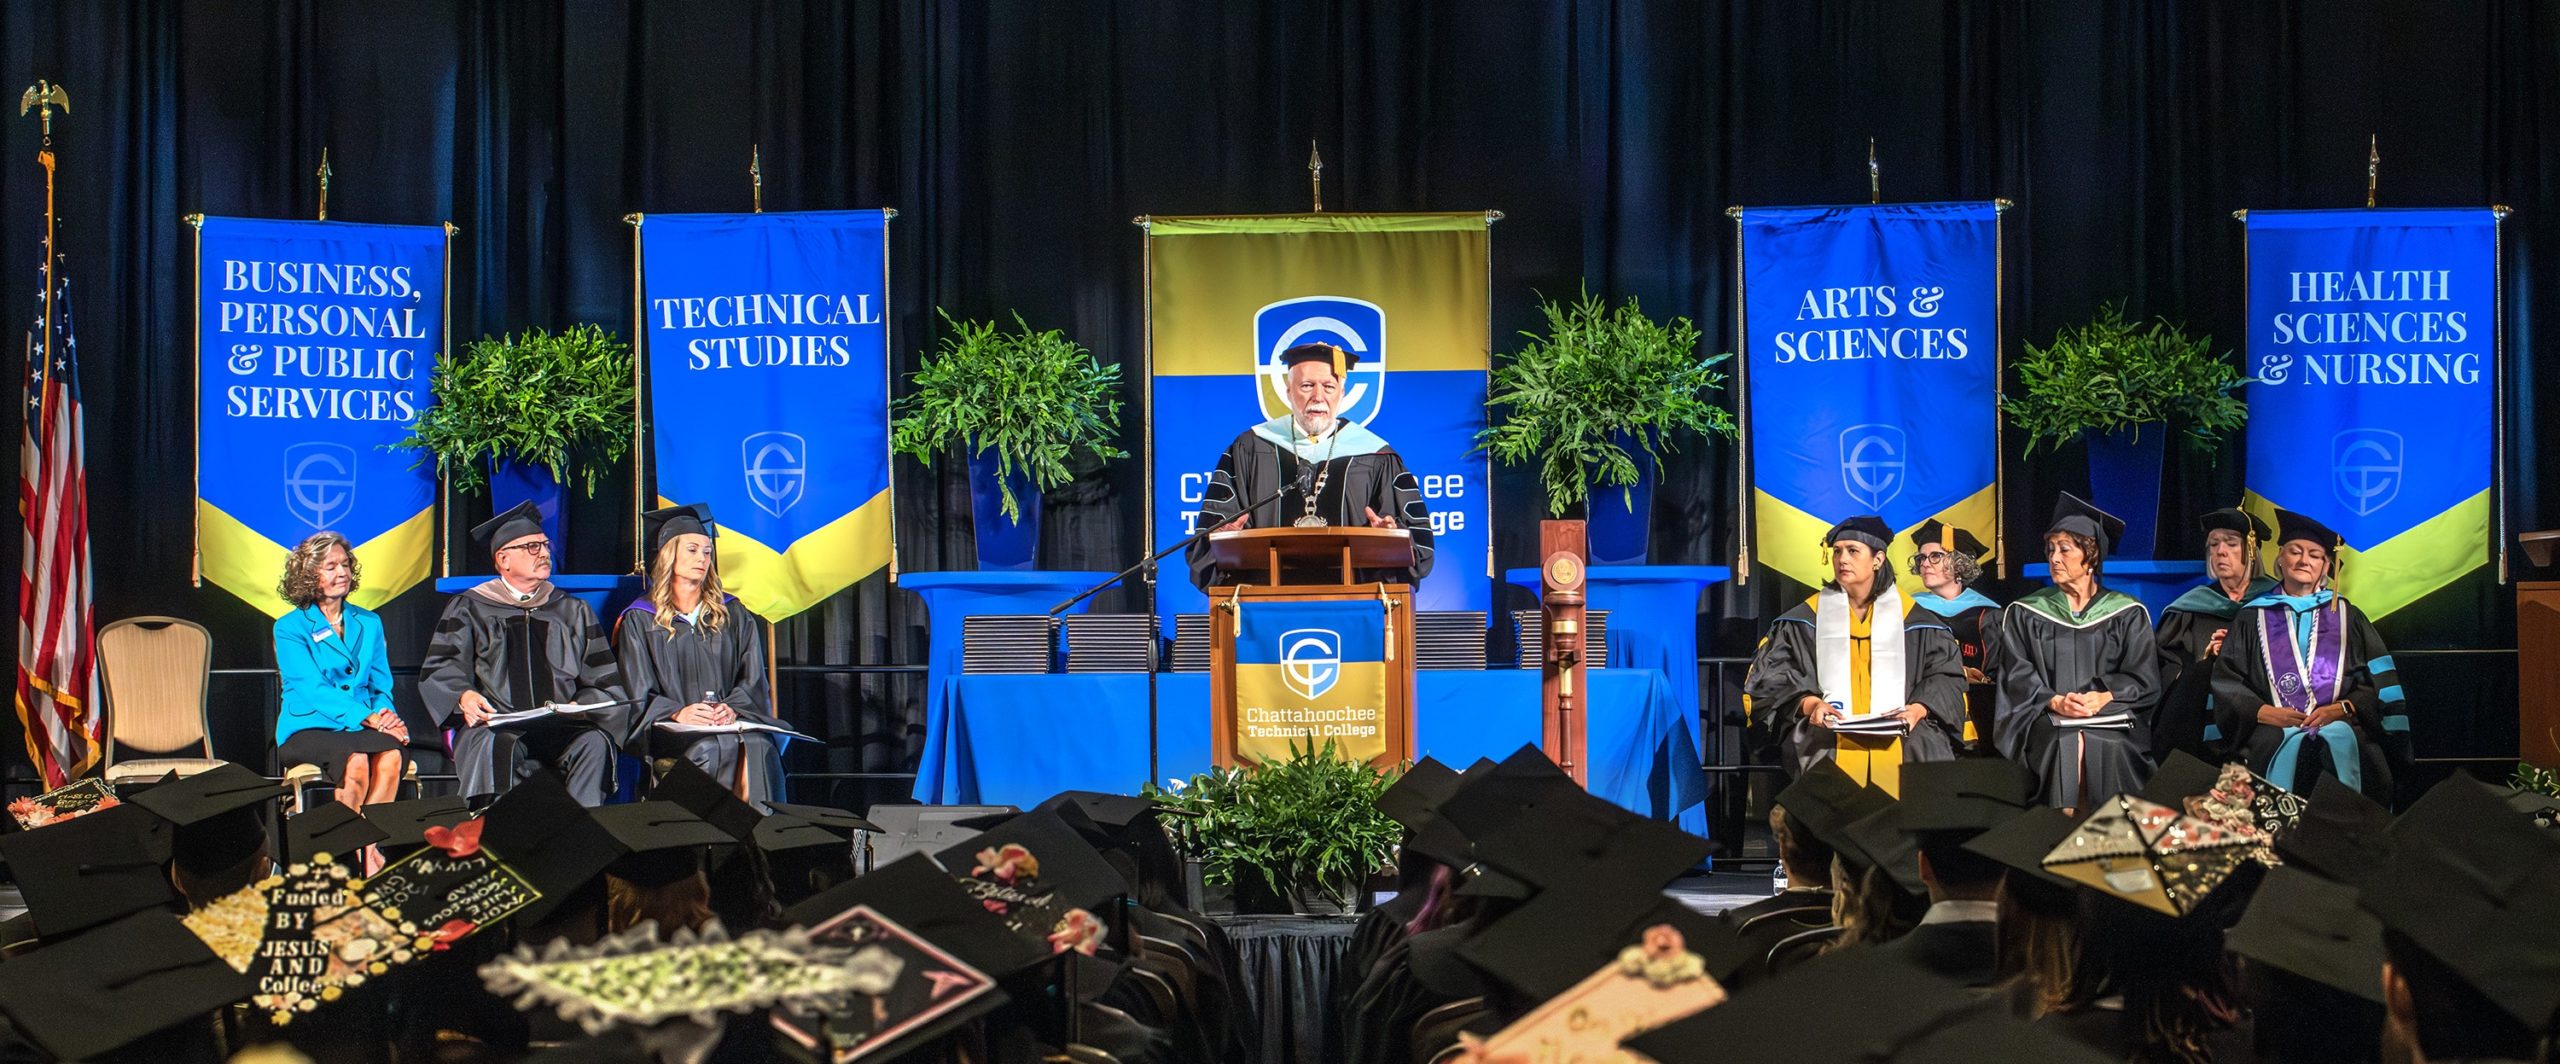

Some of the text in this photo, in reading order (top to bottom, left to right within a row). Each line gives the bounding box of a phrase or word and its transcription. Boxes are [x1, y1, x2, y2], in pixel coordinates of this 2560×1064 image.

[223, 260, 421, 303] BUSINESS,
[2290, 270, 2450, 303] HEALTH
[653, 294, 881, 330] TECHNICAL
[1796, 285, 1945, 321] ARTS &
[220, 301, 427, 339] PERSONAL
[2272, 311, 2468, 345] SCIENCES
[227, 344, 416, 381] & PUBLIC
[688, 335, 851, 370] STUDIES
[1774, 328, 1969, 364] SCIENCES
[2257, 353, 2480, 386] & NURSING
[226, 385, 416, 422] SERVICES
[1246, 706, 1376, 723] Chattahoochee
[1324, 723, 1376, 738] College
[271, 887, 344, 906] Fueled
[471, 895, 520, 925] MOM
[275, 911, 308, 931] BY
[260, 940, 331, 958] JESUS
[269, 957, 324, 976] AND
[259, 975, 323, 995] Coffee
